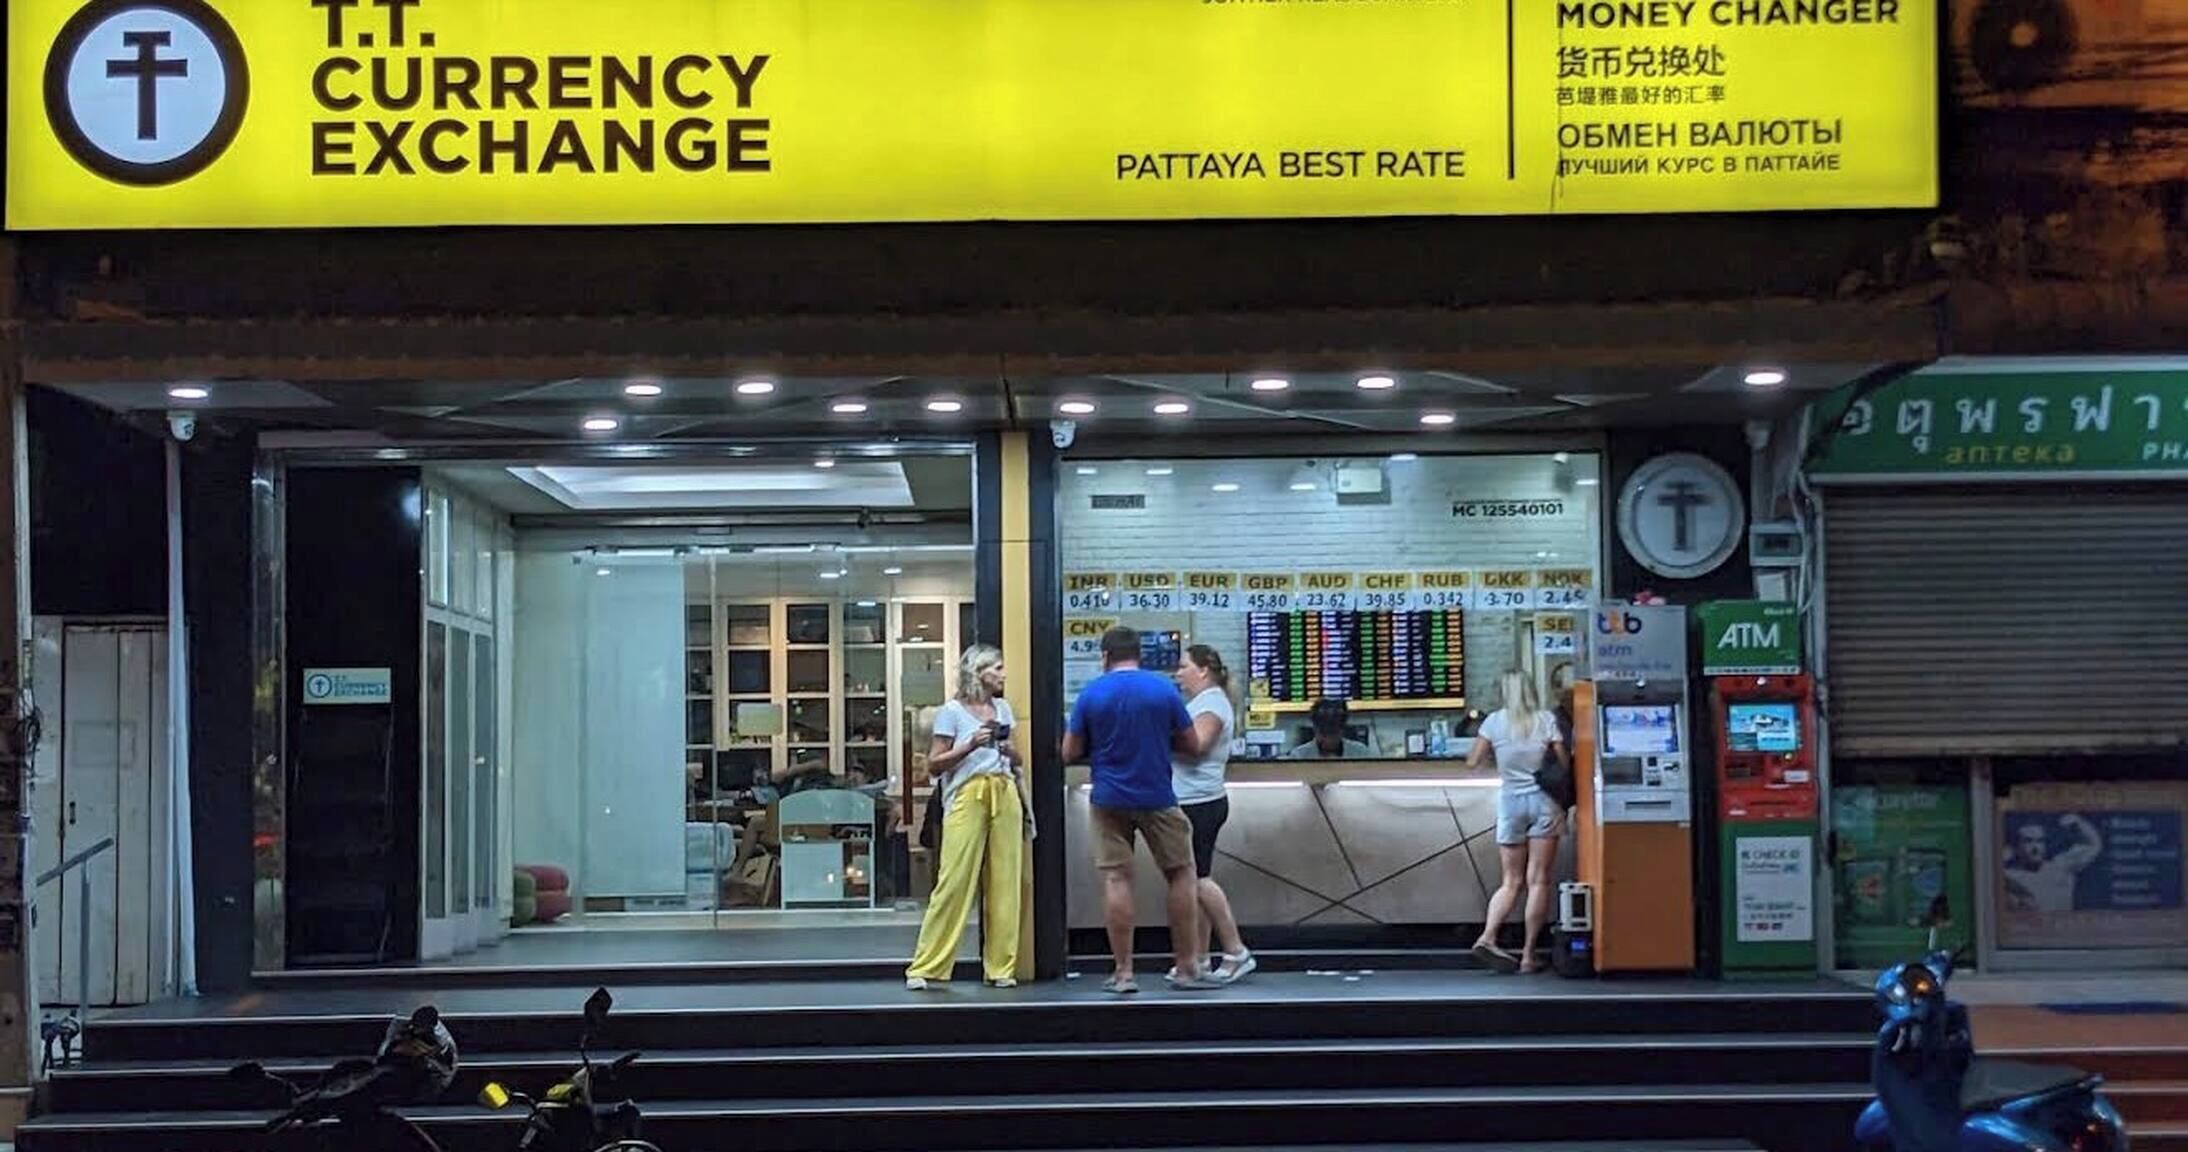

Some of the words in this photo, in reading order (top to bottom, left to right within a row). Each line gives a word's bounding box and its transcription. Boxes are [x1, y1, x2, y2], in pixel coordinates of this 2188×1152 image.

[1557, 1, 1702, 29] MONEY
[1710, 0, 1899, 25] CHANGER
[312, 0, 435, 47] T.T.
[1557, 45, 1726, 77] 货币兑换处
[311, 55, 770, 111] CURRENCY
[1556, 85, 1726, 106] 芭堤雅最好的汇率
[1557, 123, 1677, 149] ОБМЕН
[1689, 119, 1842, 147] ВАЛЮТЫ
[312, 119, 770, 176] EXCHANGE
[1116, 153, 1266, 180] PATTAYA
[1279, 151, 1366, 178] BEST
[1377, 151, 1465, 177] RATE
[1557, 155, 1649, 176] ЛУЧШИЙ
[1658, 157, 1715, 174] КУРС
[1723, 157, 1737, 172] В
[1745, 153, 1841, 172] ПАТТАЙЕ
[1842, 385, 2188, 454] จตุพรฟา
[1945, 444, 2079, 465] аптека
[1452, 504, 1477, 517] MC
[1482, 503, 1563, 517] 125540101
[1071, 576, 1109, 589] INR
[1130, 574, 1170, 587] USD
[1190, 575, 1229, 588] EUR
[1248, 576, 1288, 589] GBP
[1307, 575, 1347, 588] AUD
[1366, 575, 1406, 588] CHF
[1423, 573, 1464, 586] RUB
[1130, 593, 1170, 608] 36.30
[1190, 592, 1230, 607] 39.12
[1247, 593, 1288, 608] 45.80
[1307, 592, 1347, 608] 23.62
[1366, 592, 1406, 607] 39.85
[1423, 592, 1464, 606] 0.342
[1717, 622, 1780, 649] ATM
